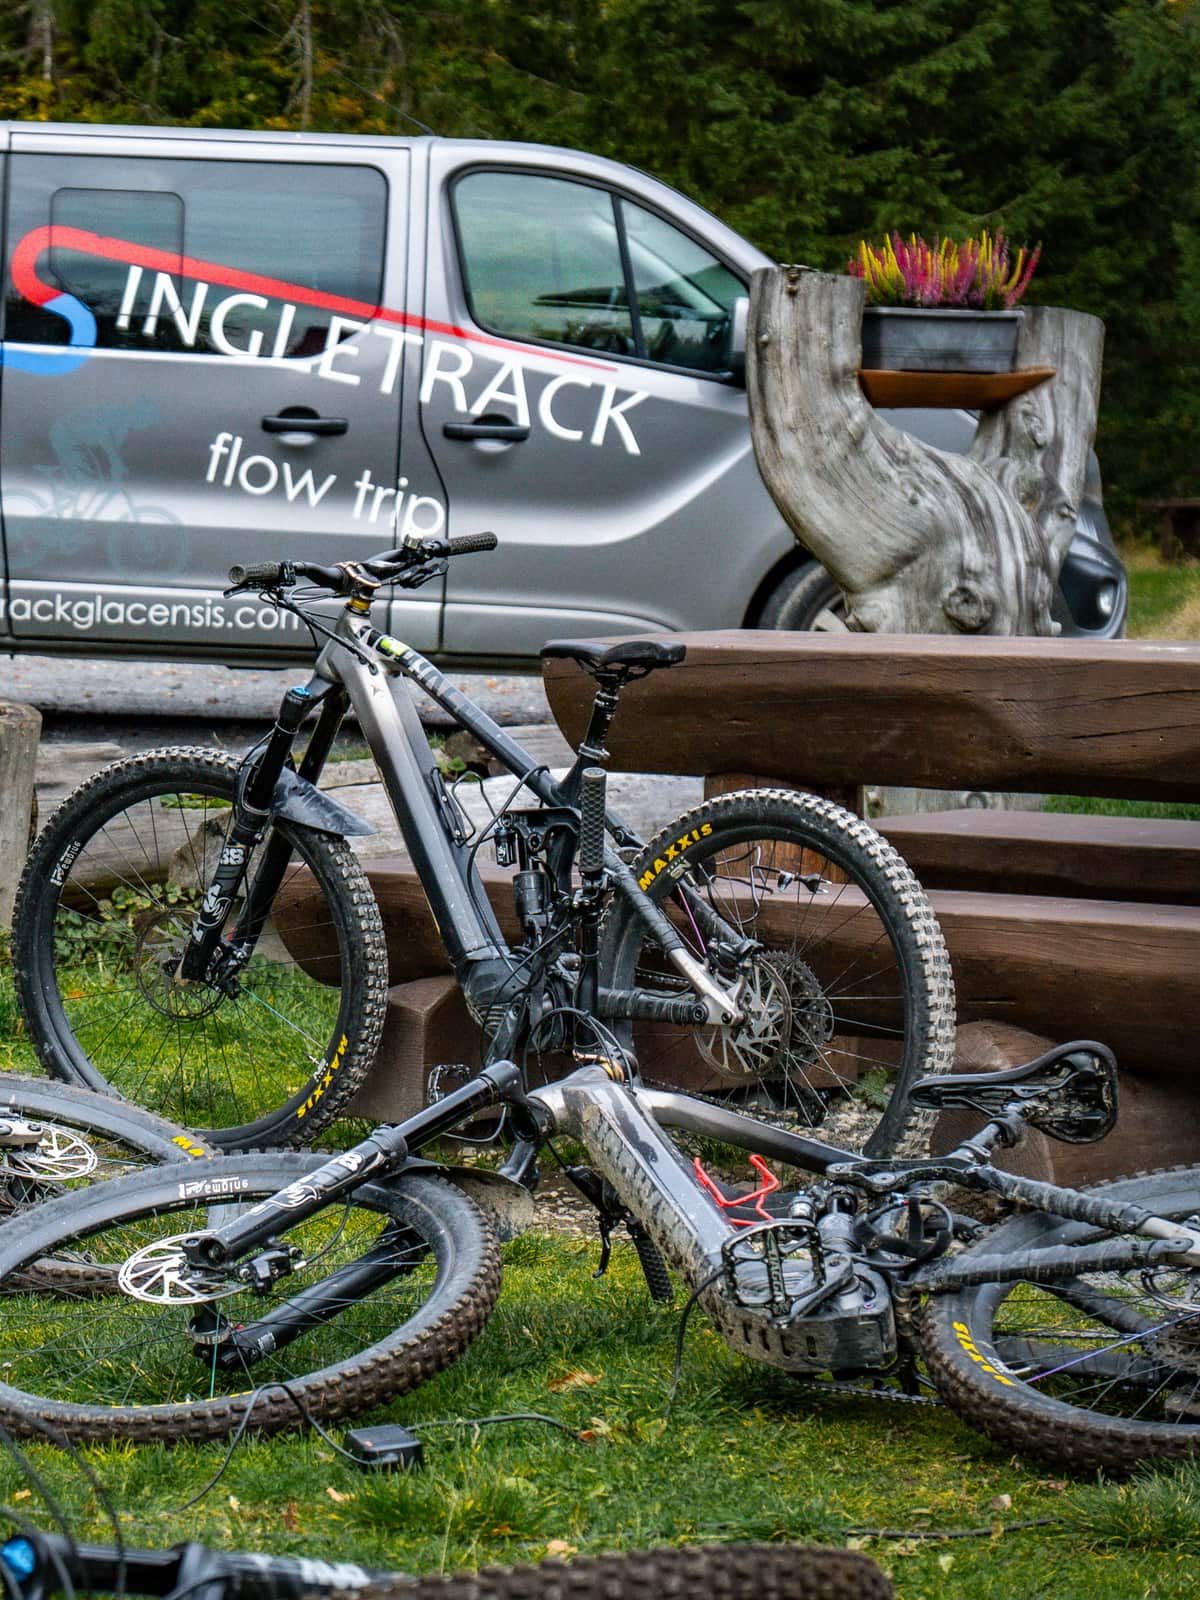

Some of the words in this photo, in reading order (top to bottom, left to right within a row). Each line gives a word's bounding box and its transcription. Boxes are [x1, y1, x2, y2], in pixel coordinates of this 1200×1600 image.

[206, 432, 337, 507] flow
[352, 469, 446, 541] trip
[639, 823, 713, 892] MAXXIS
[296, 1032, 349, 1119] MAXXIS
